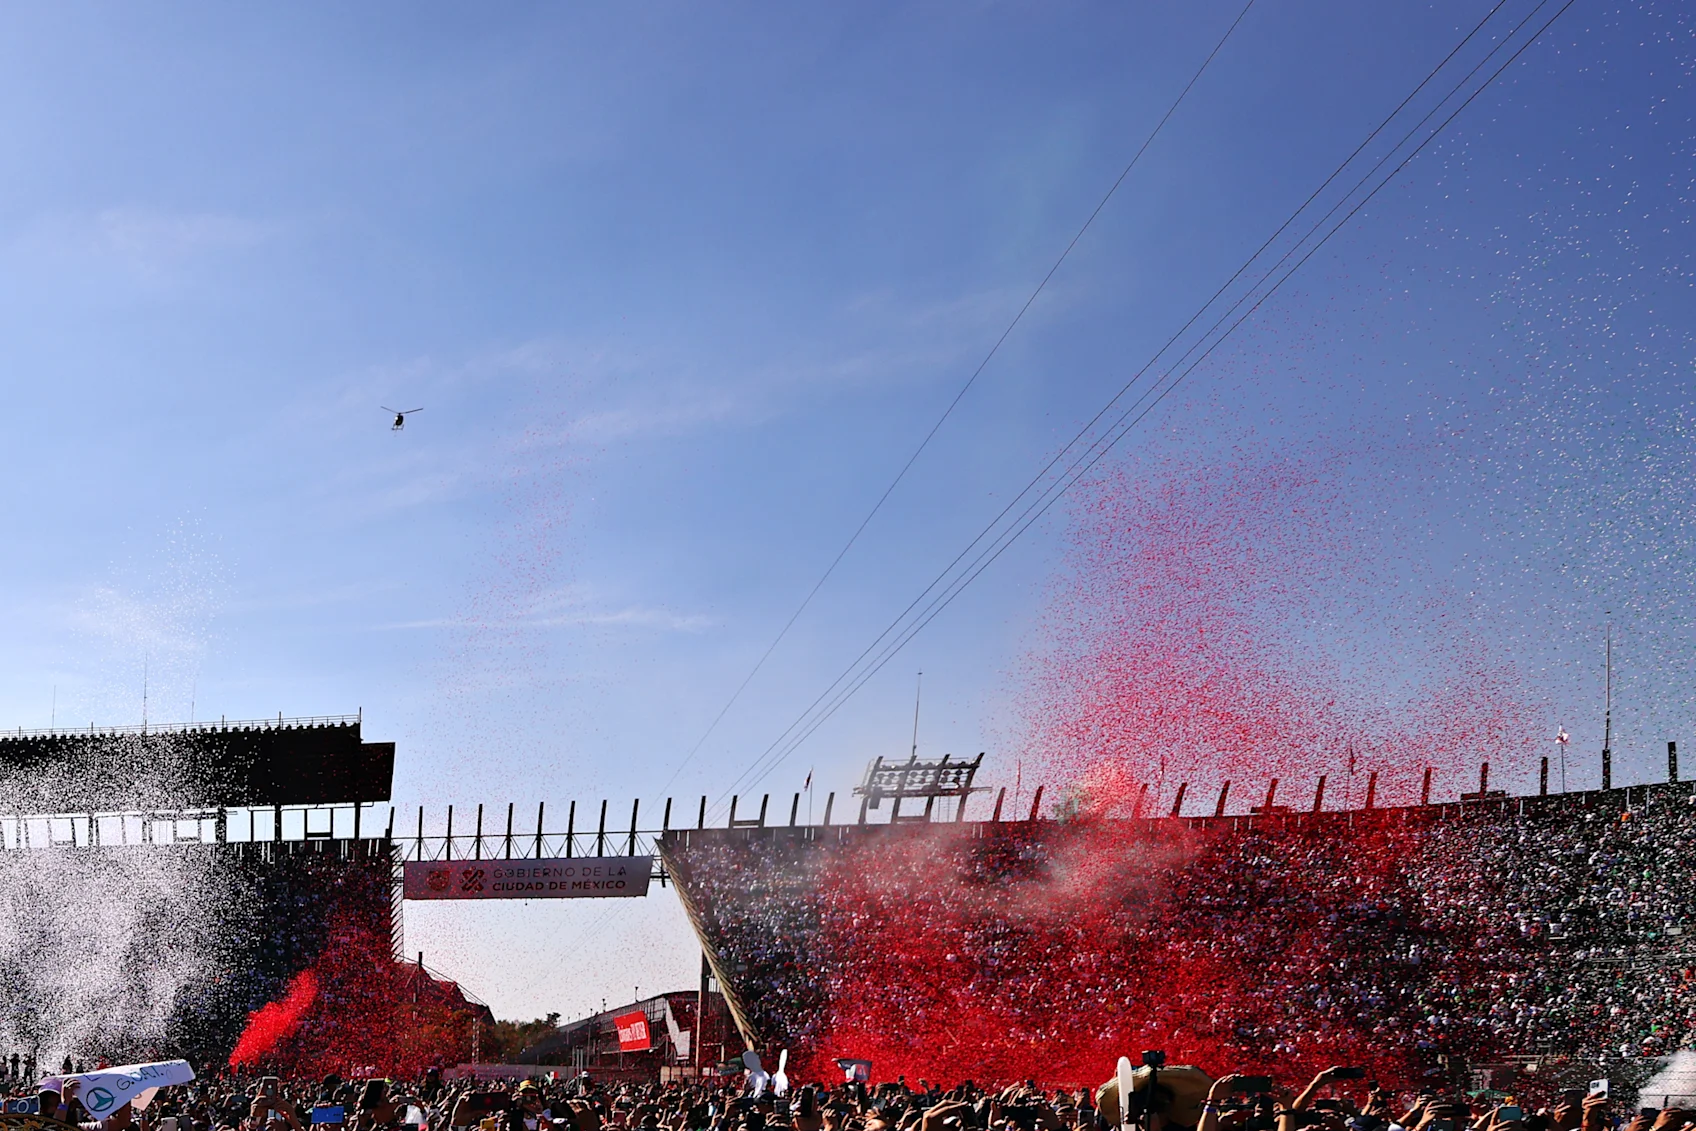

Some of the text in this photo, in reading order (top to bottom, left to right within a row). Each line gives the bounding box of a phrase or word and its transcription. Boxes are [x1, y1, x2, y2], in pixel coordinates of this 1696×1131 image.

[493, 866, 627, 879] GOBIERNO DE LA
[492, 878, 626, 892] CIUDAD DE MÉXICO
